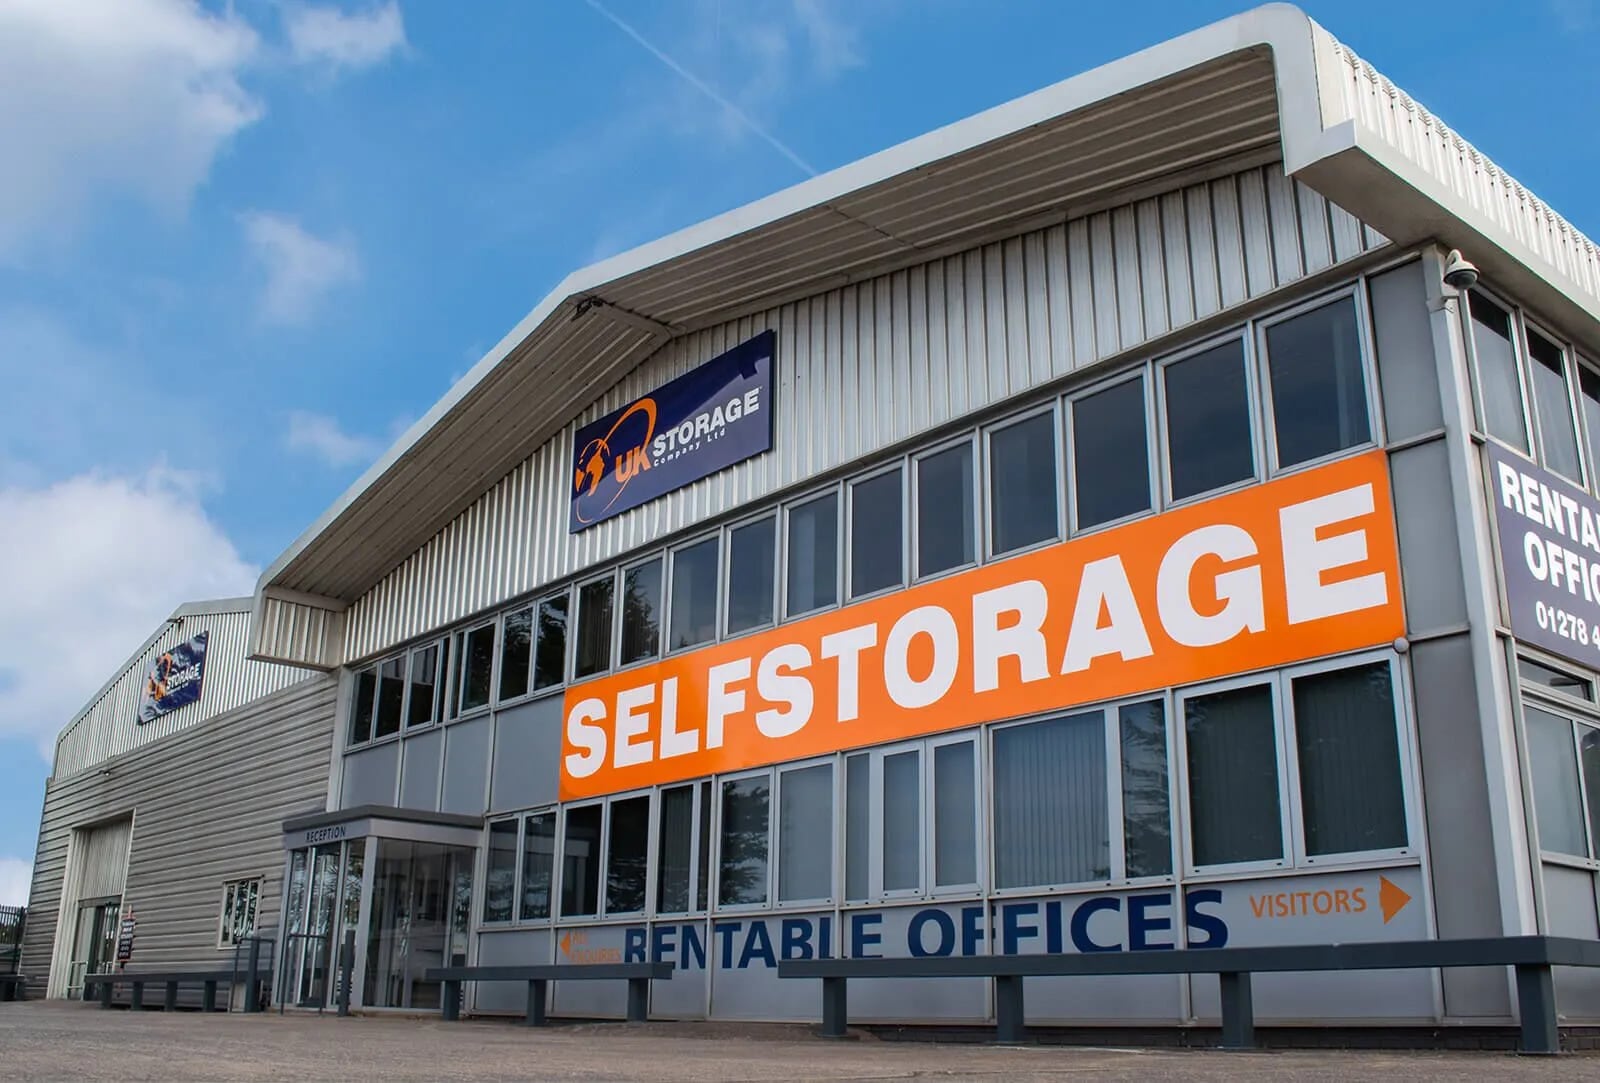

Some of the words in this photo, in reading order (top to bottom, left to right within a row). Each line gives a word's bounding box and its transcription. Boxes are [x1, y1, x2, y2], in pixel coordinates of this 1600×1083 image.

[615, 445, 651, 483] UK
[652, 387, 760, 457] STORAGE
[653, 441, 700, 467] Company
[707, 428, 725, 442] Ltd
[1498, 461, 1600, 553] RENTA
[1536, 600, 1589, 646] 01278
[167, 662, 201, 690] STORAGE
[305, 826, 346, 842] RECEPTION
[1250, 887, 1367, 918] VISITORS
[624, 913, 883, 970] RENTABLE
[908, 889, 1229, 958] OFFICES
